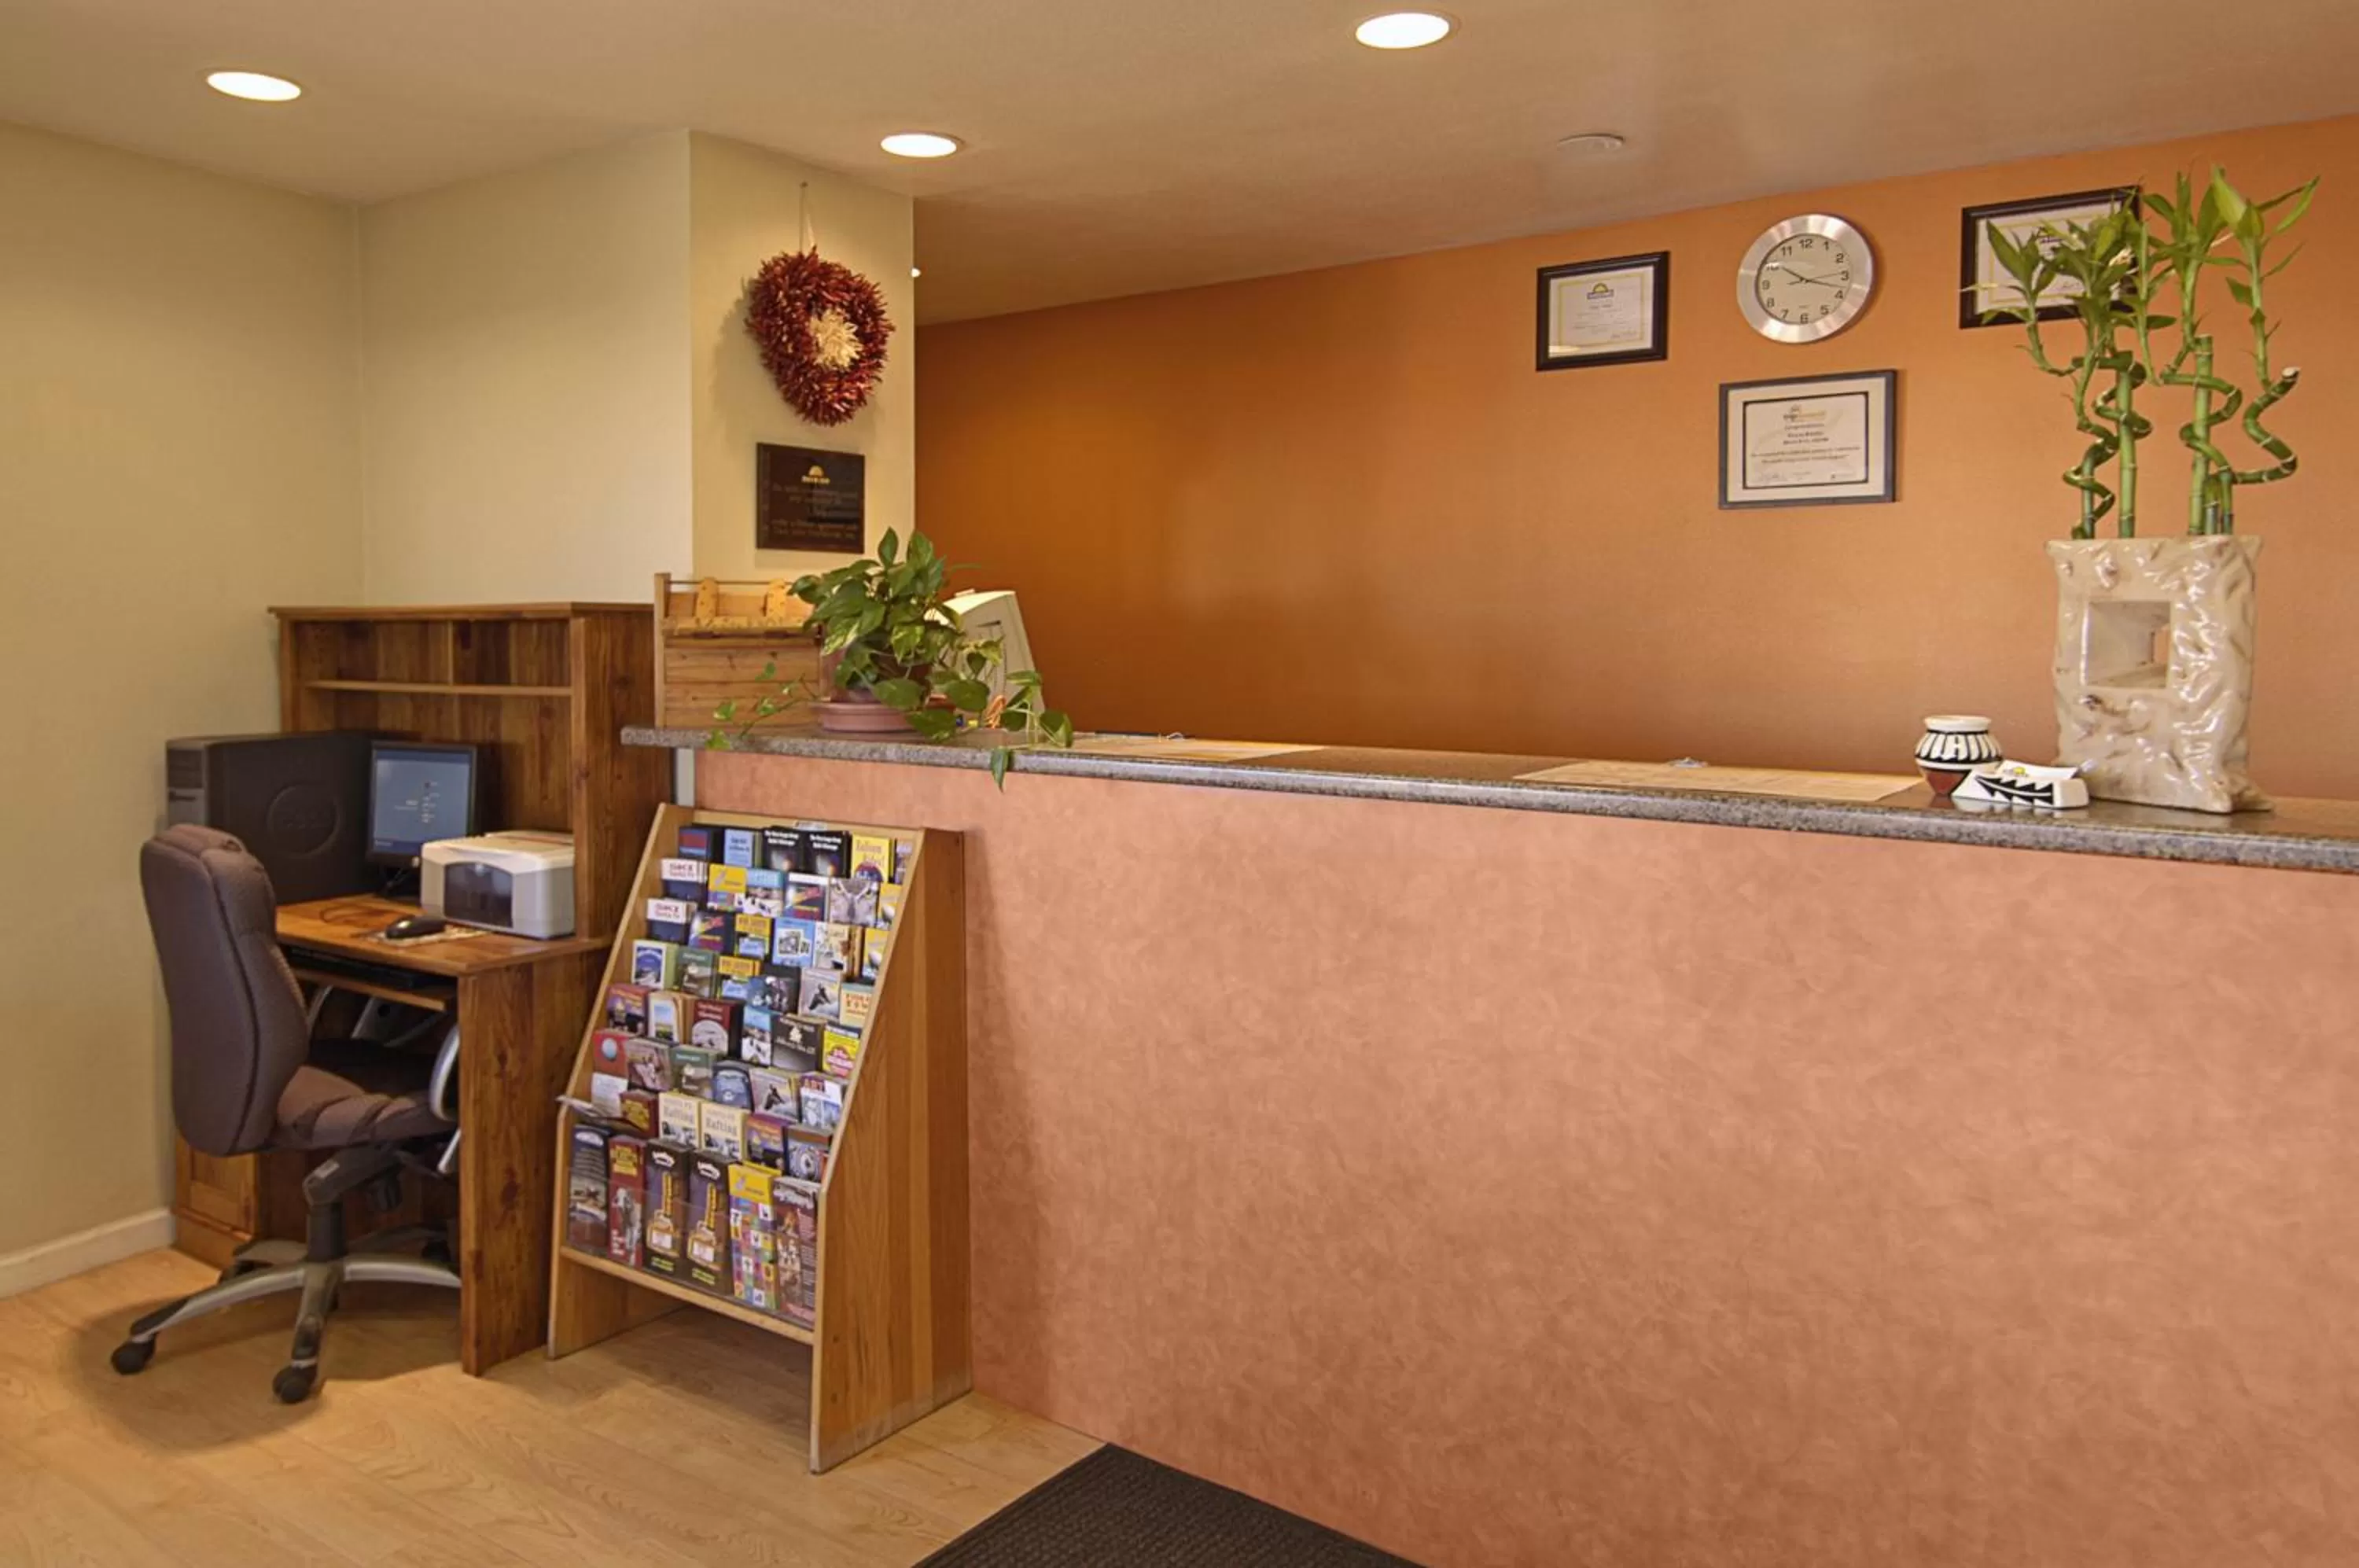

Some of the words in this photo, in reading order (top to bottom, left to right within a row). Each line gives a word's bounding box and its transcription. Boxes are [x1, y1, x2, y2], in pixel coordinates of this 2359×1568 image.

[1799, 238, 1813, 249] 12
[1824, 241, 1830, 251] 1
[1781, 245, 1793, 256] 11
[1835, 252, 1845, 264] 2
[1840, 270, 1849, 282] 3
[1761, 279, 1771, 290] 9
[1834, 289, 1844, 300] 4
[1766, 297, 1776, 308] 8
[1781, 308, 1789, 320] 7
[1820, 304, 1831, 315] 5
[1800, 312, 1809, 324] 6
